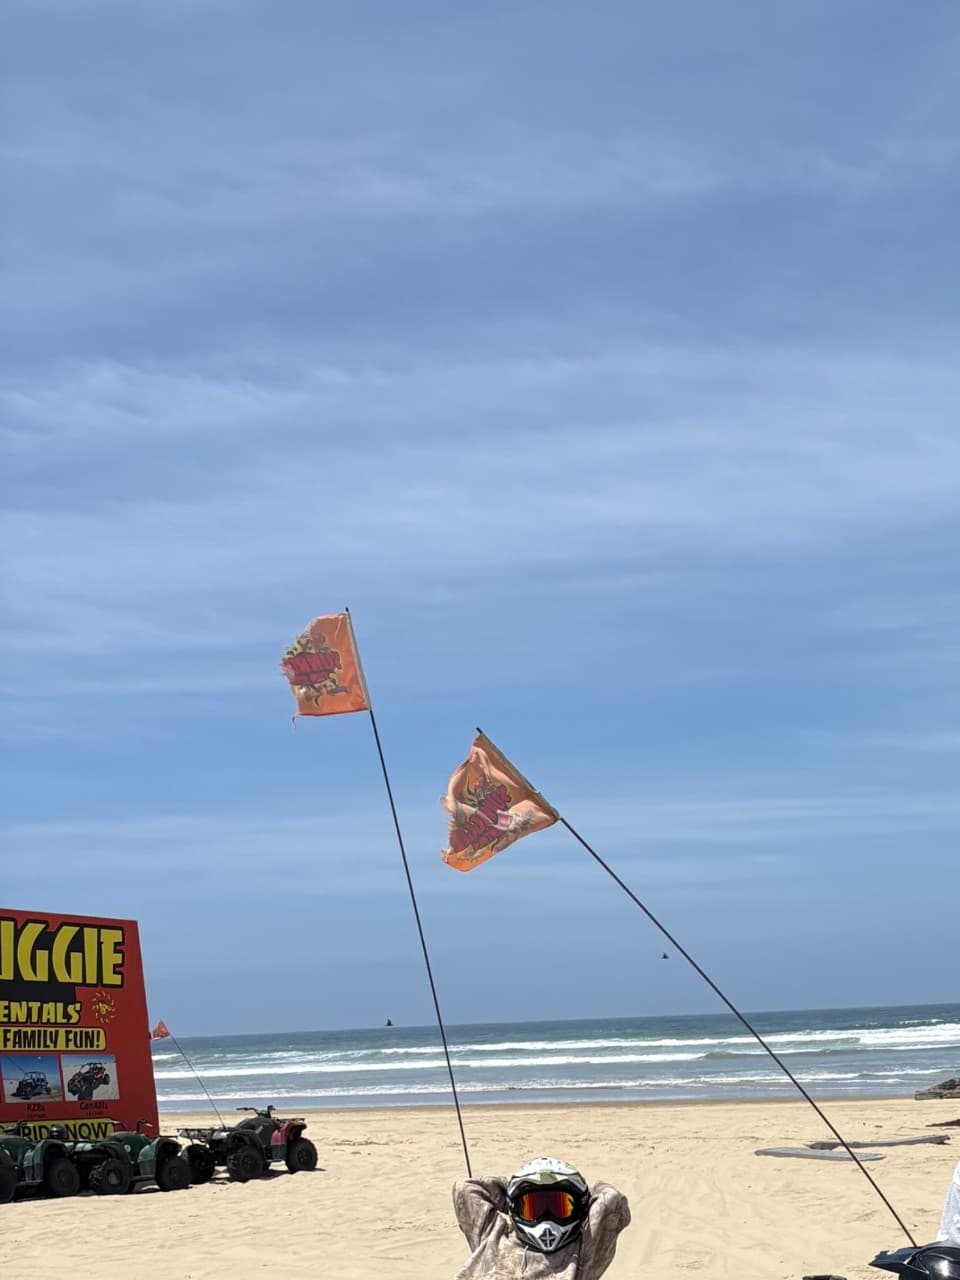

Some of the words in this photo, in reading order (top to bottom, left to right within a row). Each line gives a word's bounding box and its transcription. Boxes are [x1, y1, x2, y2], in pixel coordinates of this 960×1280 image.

[3, 1029, 59, 1048] FAMILY
[64, 1031, 101, 1048] FUN!
[22, 1123, 63, 1140] RID
[64, 1121, 108, 1140] NOW
